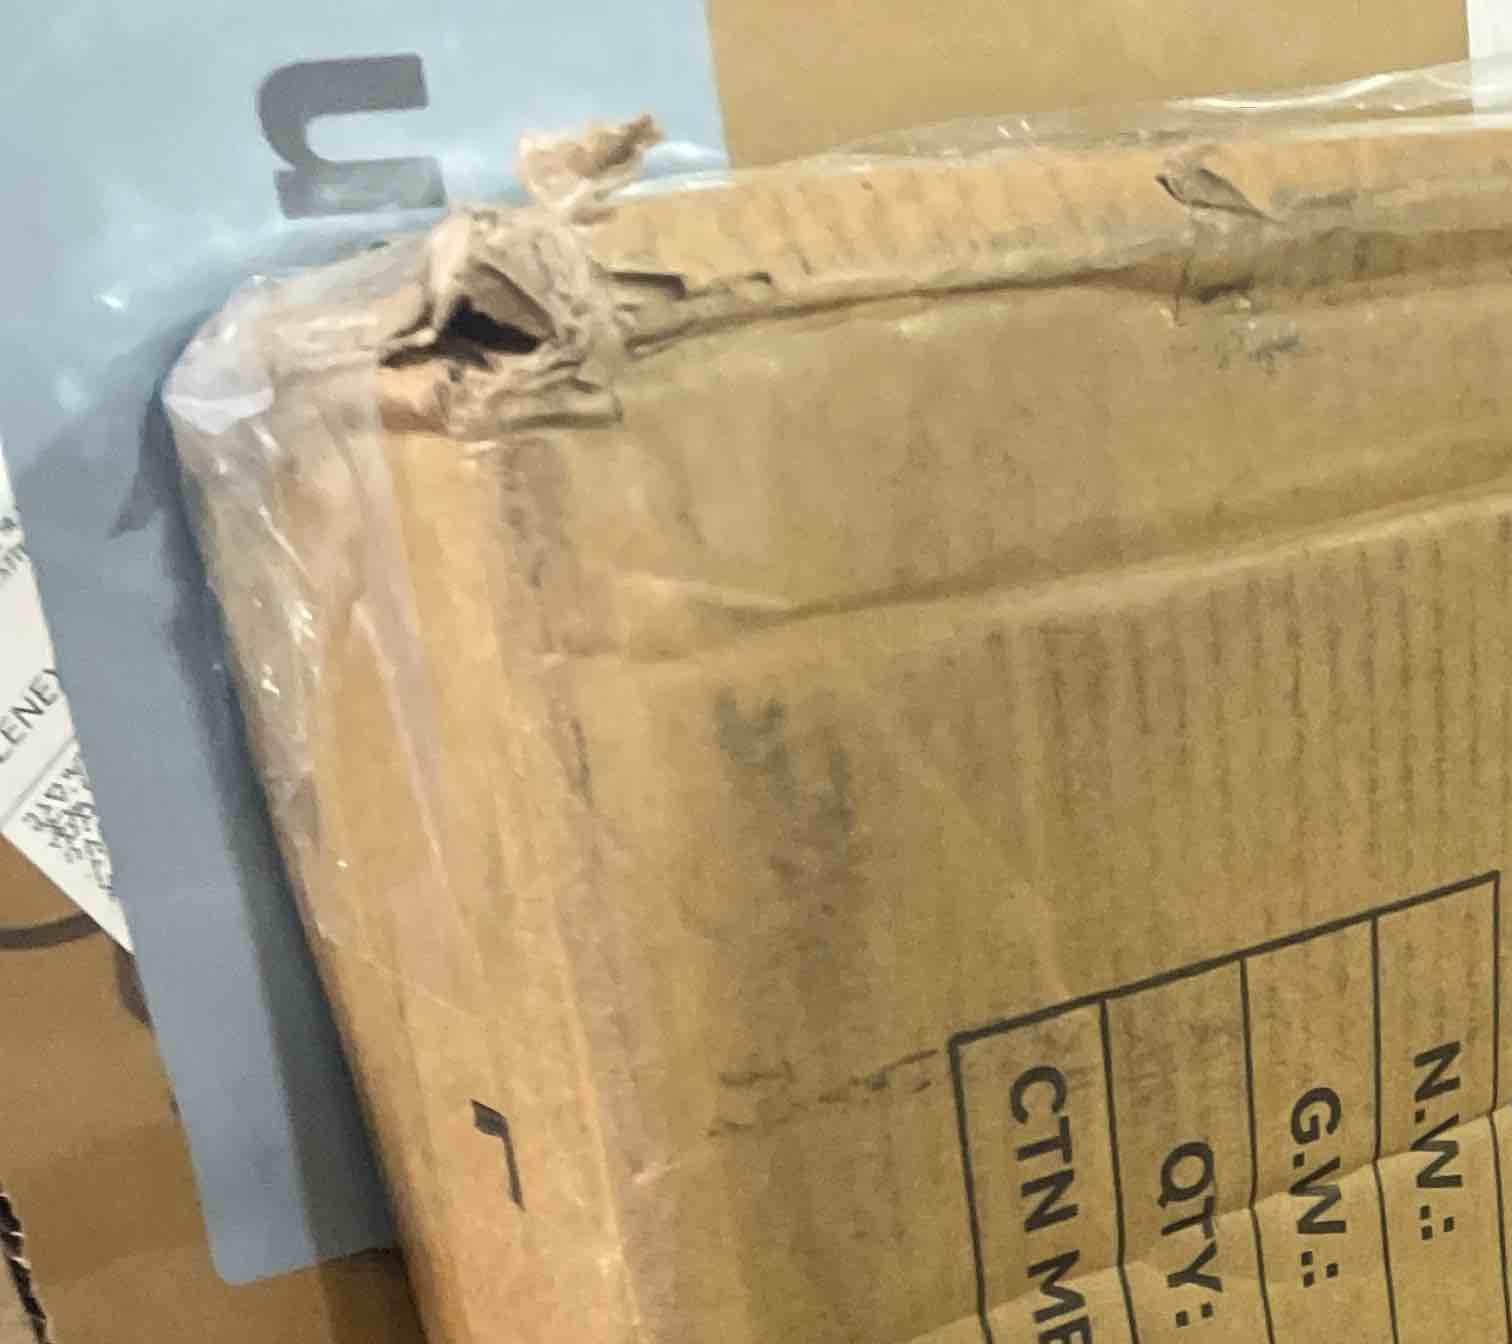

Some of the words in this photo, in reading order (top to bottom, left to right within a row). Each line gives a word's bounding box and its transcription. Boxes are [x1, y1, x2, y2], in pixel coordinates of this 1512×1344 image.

[1009, 1065, 1080, 1234] CTN
[1157, 1140, 1223, 1329] QTY:
[1288, 1087, 1347, 1288] G.W.:
[1409, 1040, 1463, 1241] N.W.:
